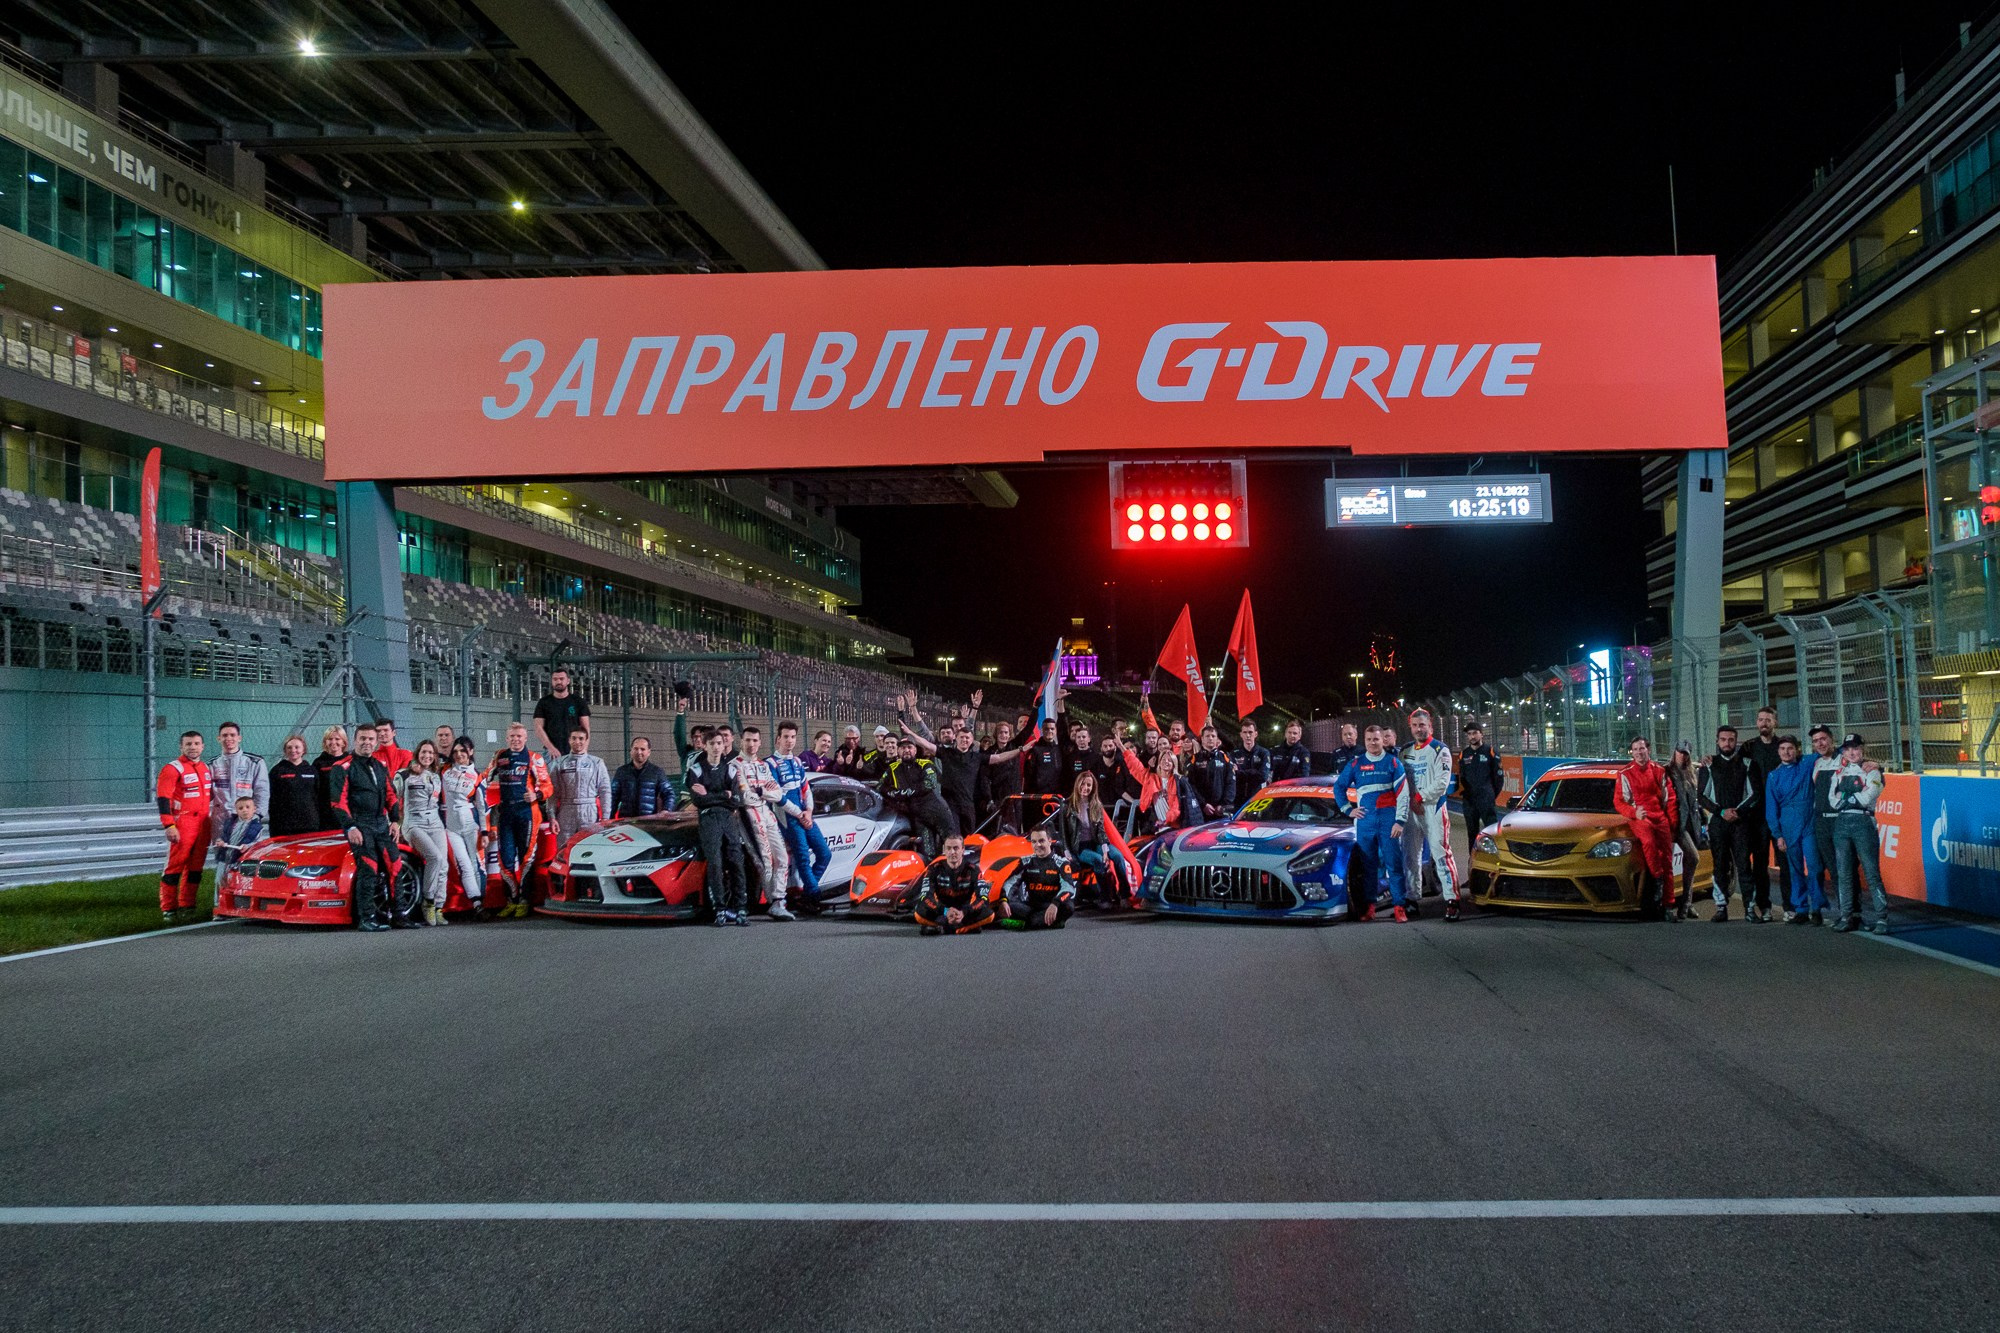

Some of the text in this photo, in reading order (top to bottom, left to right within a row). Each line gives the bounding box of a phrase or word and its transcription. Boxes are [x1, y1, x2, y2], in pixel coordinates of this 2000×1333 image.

[0, 90, 241, 235] ЛЬШЕ, ЧЕМ ГОНКИ!
[481, 325, 1099, 420] ЗАПРАВЛЕНО
[1404, 486, 1529, 498] time 23.10.2022
[1340, 496, 1388, 508] SOCHI
[1449, 498, 1530, 517] 18:25:19
[1244, 798, 1274, 813] 48
[1875, 800, 1902, 815] ИВО
[1982, 825, 2000, 839] СЕТ
